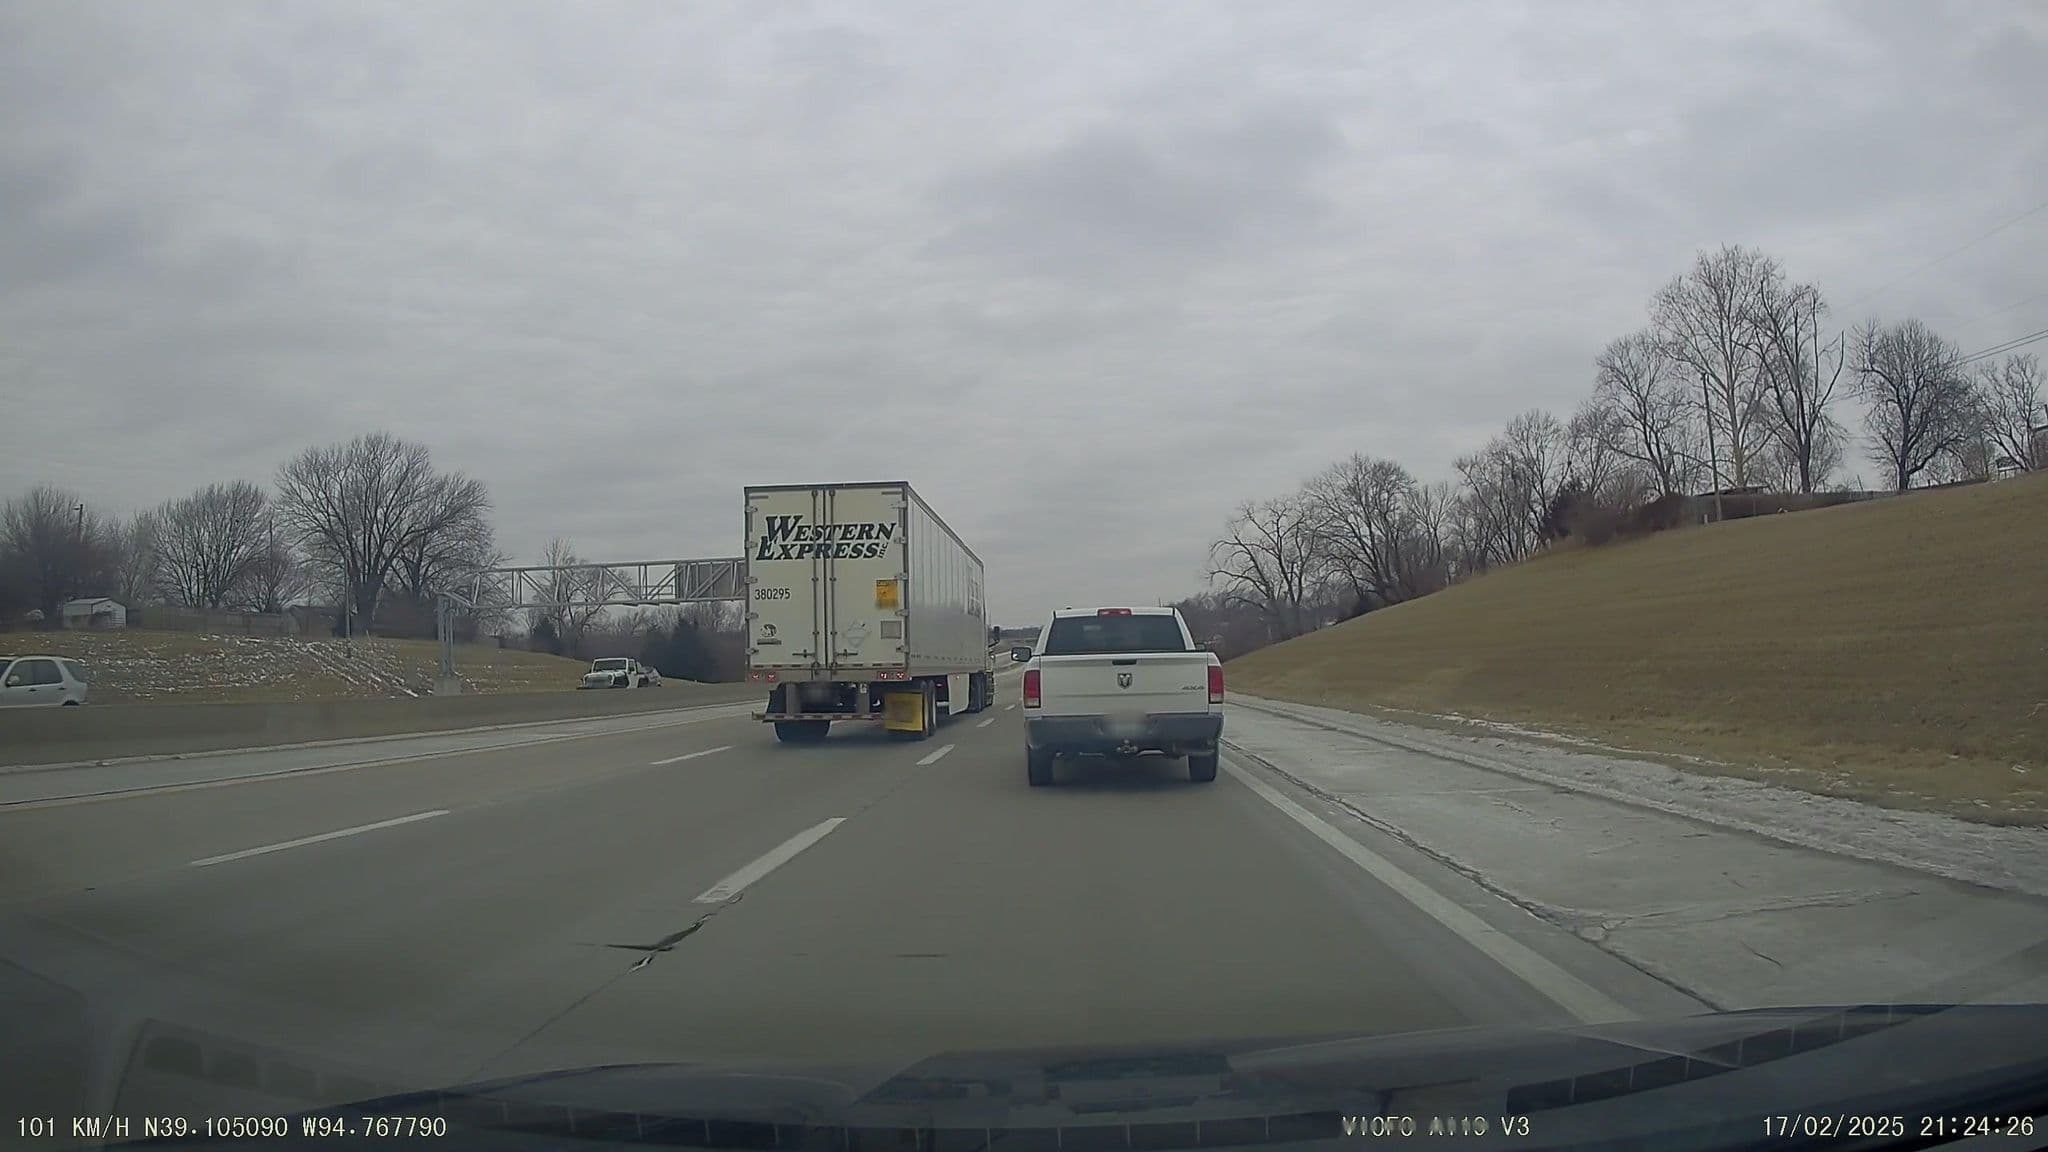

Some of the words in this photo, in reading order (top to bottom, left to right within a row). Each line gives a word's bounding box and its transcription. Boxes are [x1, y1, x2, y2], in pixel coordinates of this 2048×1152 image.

[766, 515, 896, 542] WESTERN
[756, 536, 880, 560] EXPRESS
[754, 588, 790, 600] 380295
